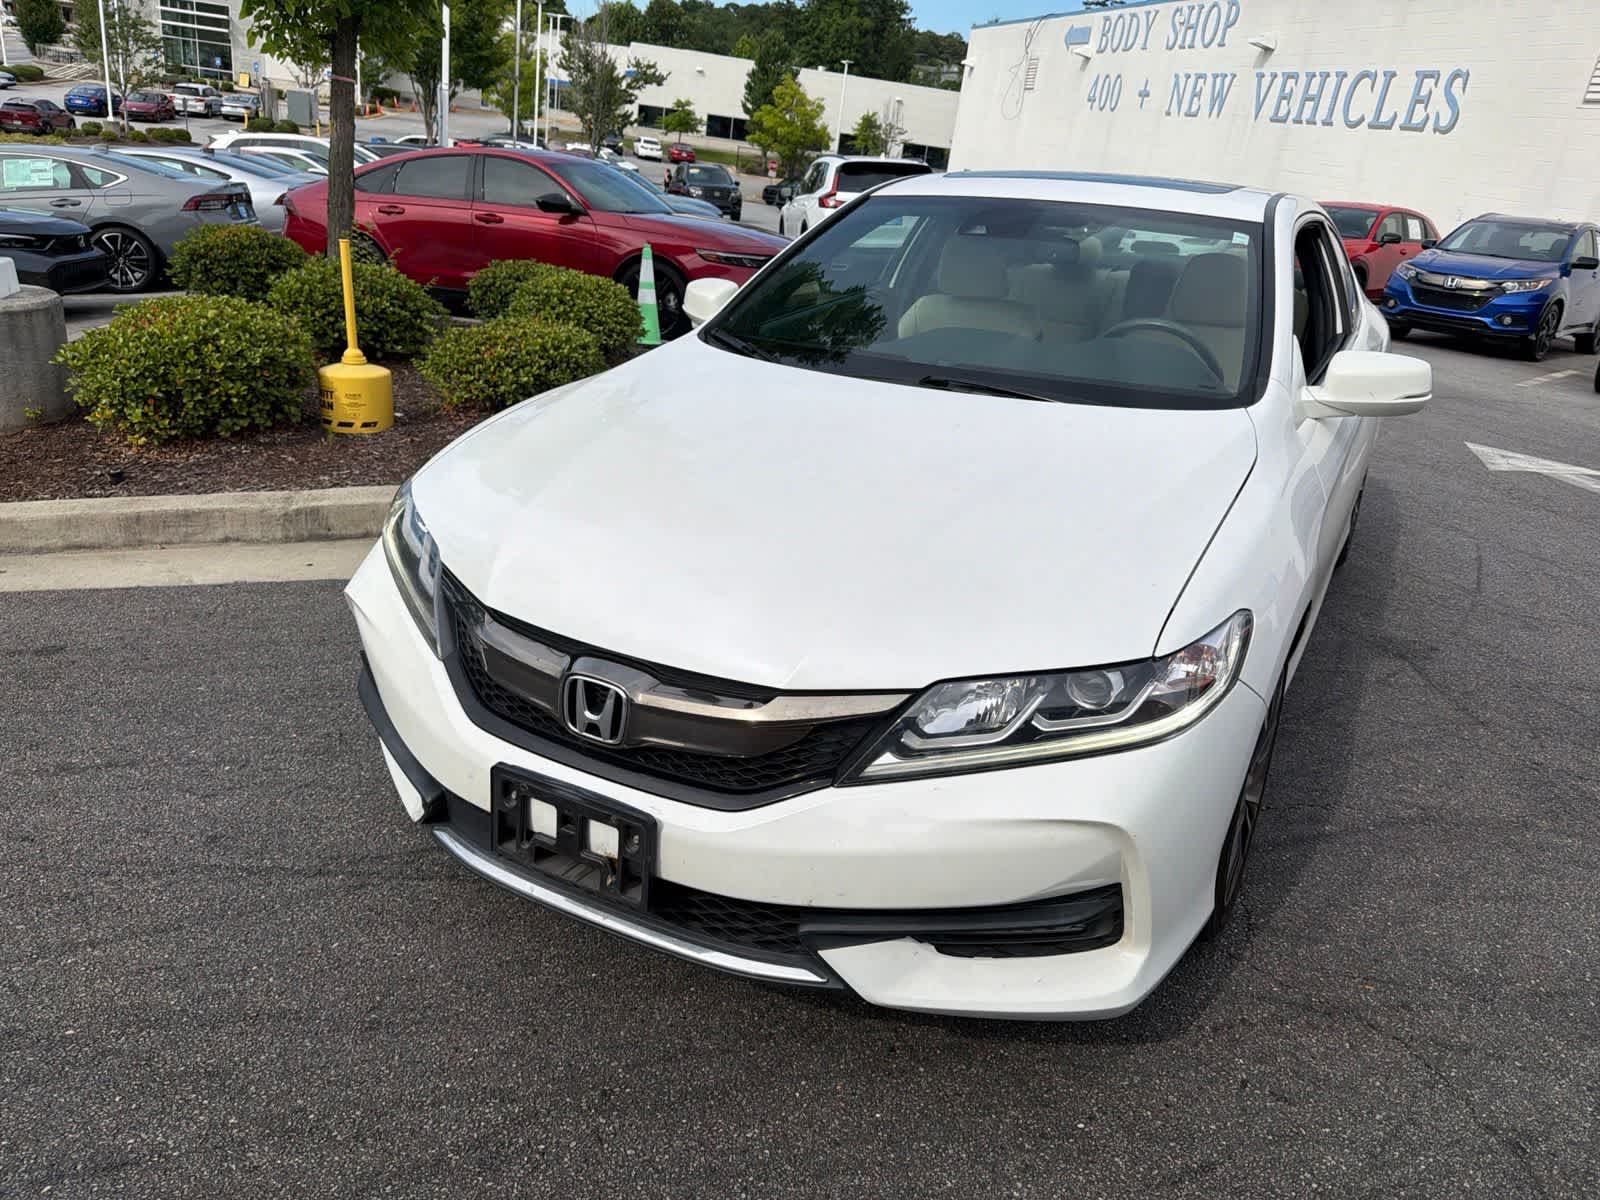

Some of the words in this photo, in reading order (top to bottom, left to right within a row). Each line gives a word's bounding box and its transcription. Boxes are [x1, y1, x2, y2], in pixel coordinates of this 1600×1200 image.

[1096, 9, 1160, 54] BODY
[1166, 0, 1241, 51] SHOP
[1087, 73, 1123, 113] 400
[1138, 78, 1150, 109] +
[1165, 73, 1237, 119] NEW
[1254, 68, 1470, 135] VEHICLES
